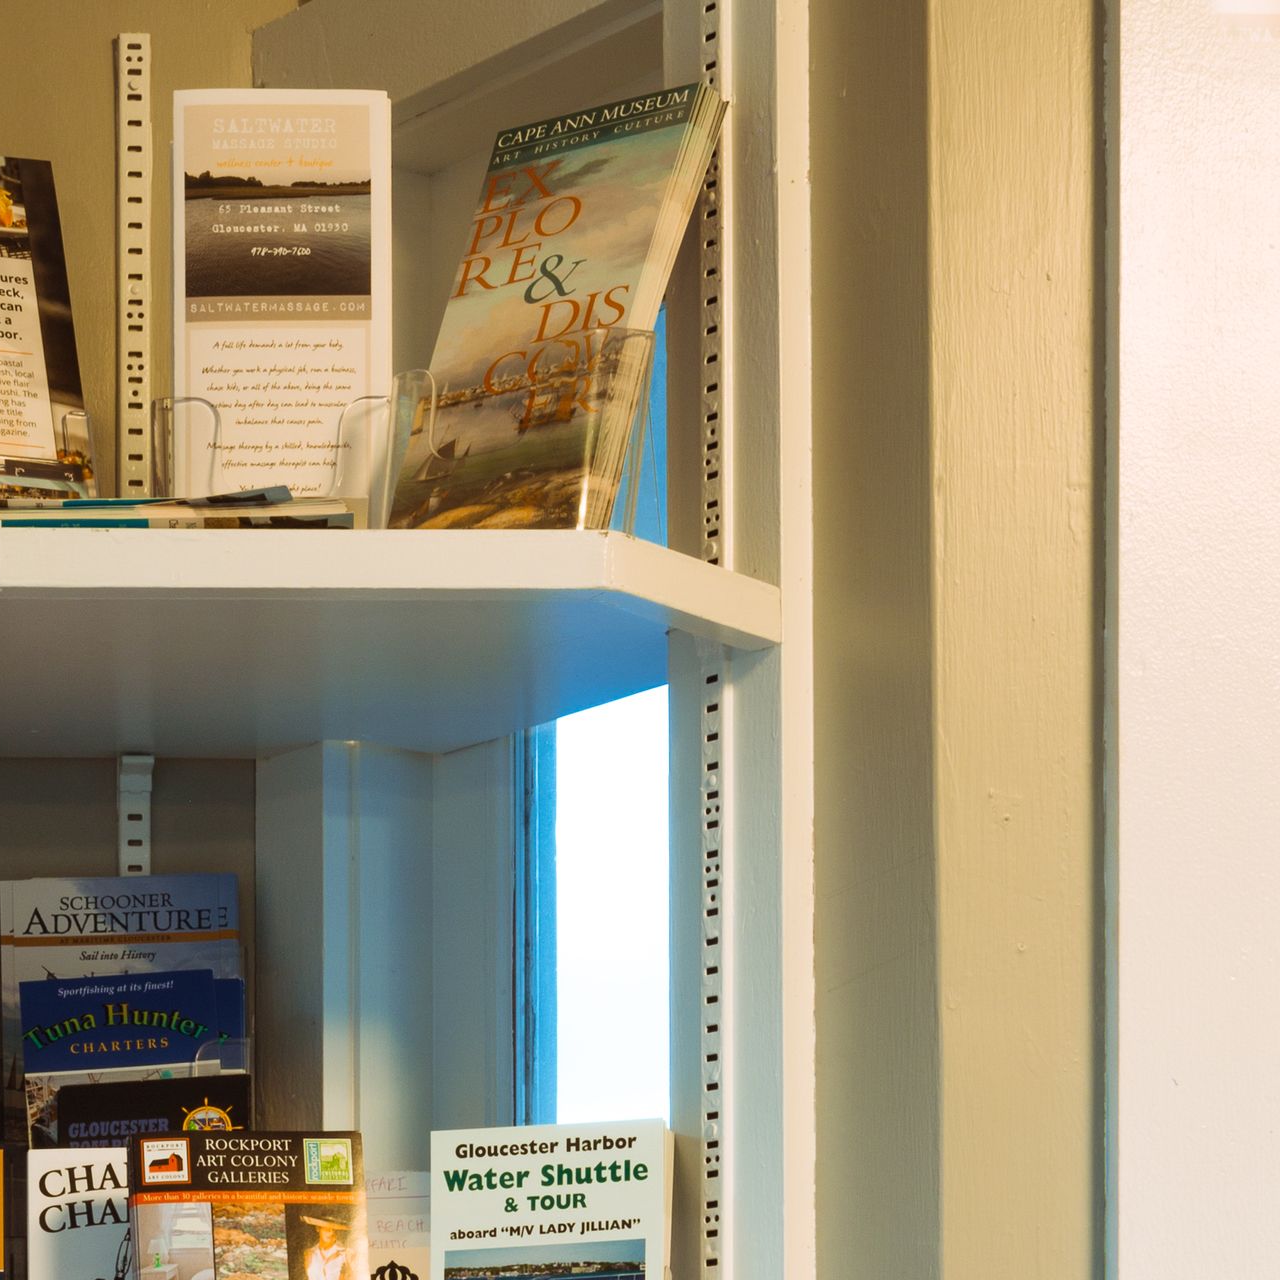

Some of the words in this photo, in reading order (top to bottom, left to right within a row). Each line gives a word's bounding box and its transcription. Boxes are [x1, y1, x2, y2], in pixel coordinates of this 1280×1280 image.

[213, 118, 337, 134] SALTWATER
[498, 128, 548, 150] CAPE
[552, 112, 596, 134] ANN
[601, 90, 689, 122] MUSEUM
[0, 299, 22, 311] can
[190, 301, 366, 314] SALTWATERMASSAGE.COM
[4, 315, 11, 325] a
[60, 894, 172, 911] SCHOONER
[24, 906, 211, 934] ADVENTURE
[23, 1010, 97, 1049] Tuna
[105, 1003, 209, 1039] Hunter
[70, 1038, 169, 1054] CHARTERS
[205, 1138, 291, 1151] ROCKPORT
[455, 1138, 559, 1159] Gloucester
[566, 1134, 637, 1152] Harbor
[196, 1154, 226, 1168] ART
[231, 1154, 298, 1168] COLONY
[208, 1171, 289, 1184] GALLERIES
[444, 1166, 532, 1192] Water
[540, 1160, 648, 1187] Shuttle
[504, 1197, 518, 1212] &
[528, 1193, 587, 1211] TOUR
[450, 1224, 497, 1241] aboard
[539, 1220, 575, 1235] LADY
